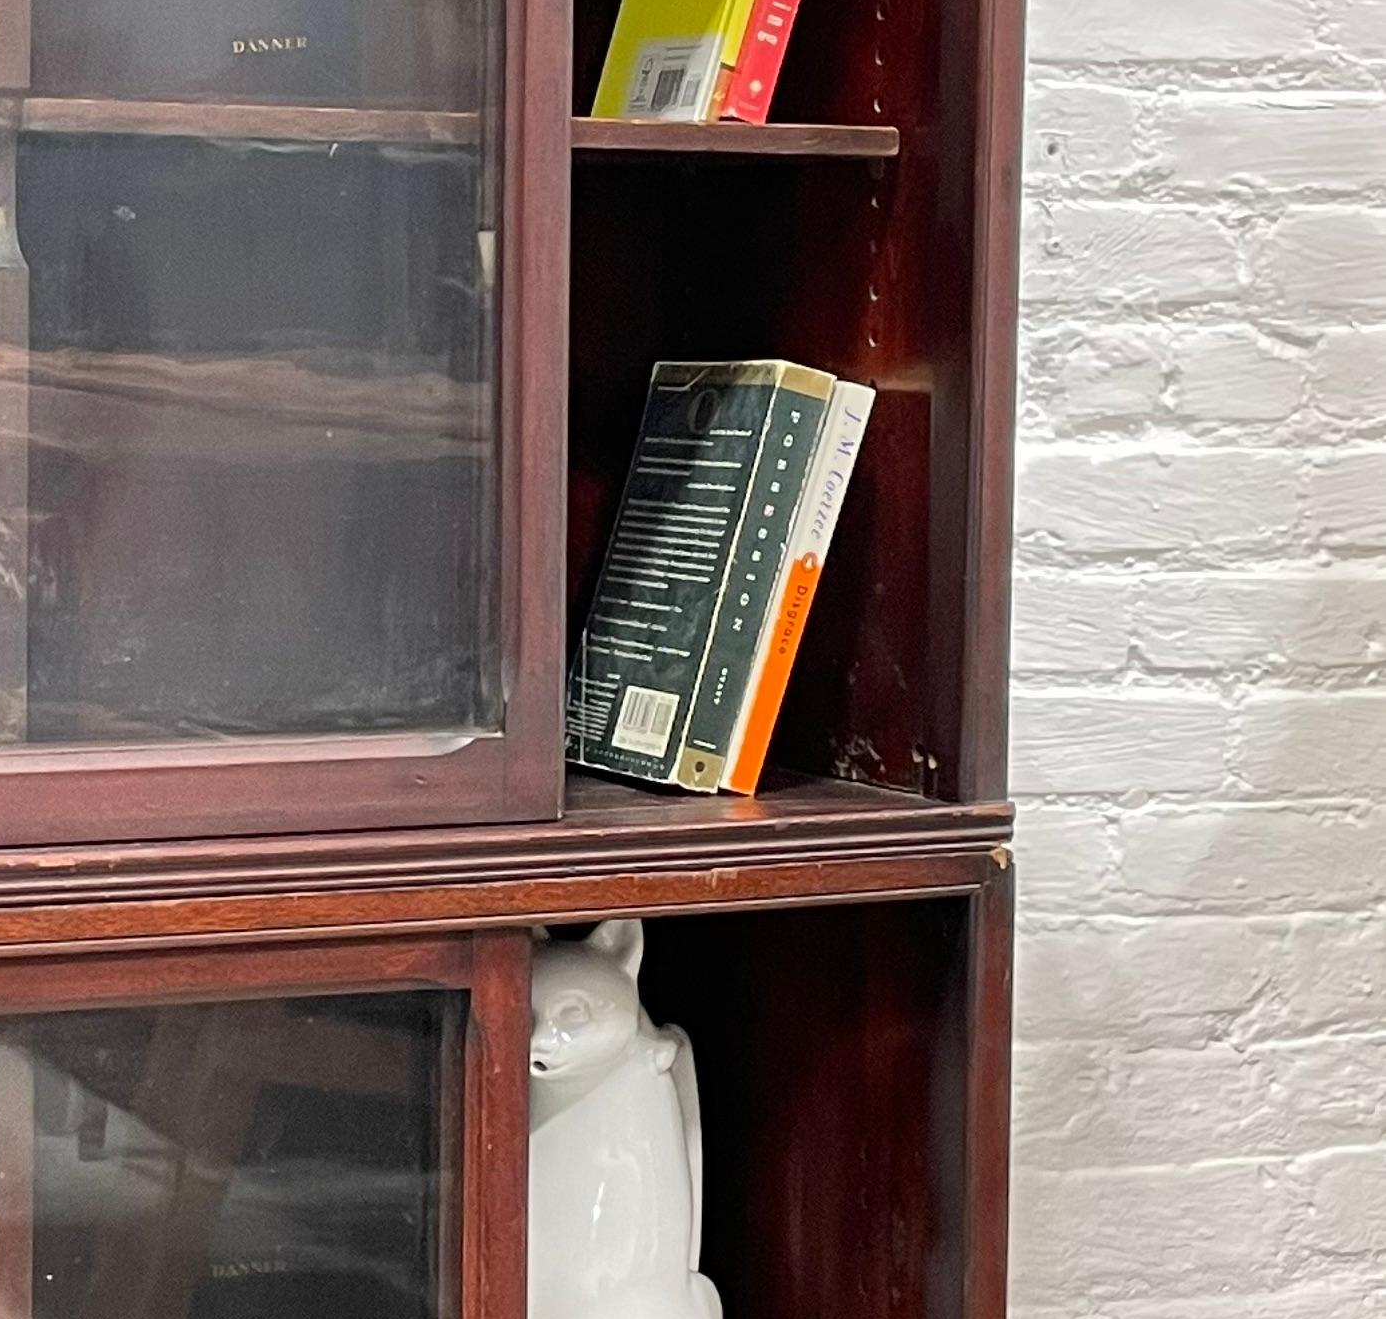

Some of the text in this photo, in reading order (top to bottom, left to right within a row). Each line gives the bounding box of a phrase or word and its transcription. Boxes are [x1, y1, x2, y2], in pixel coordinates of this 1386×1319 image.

[232, 36, 308, 54] DANNER
[842, 405, 862, 426] J.
[811, 469, 844, 540] Coetzee
[778, 584, 808, 656] Disgrace
